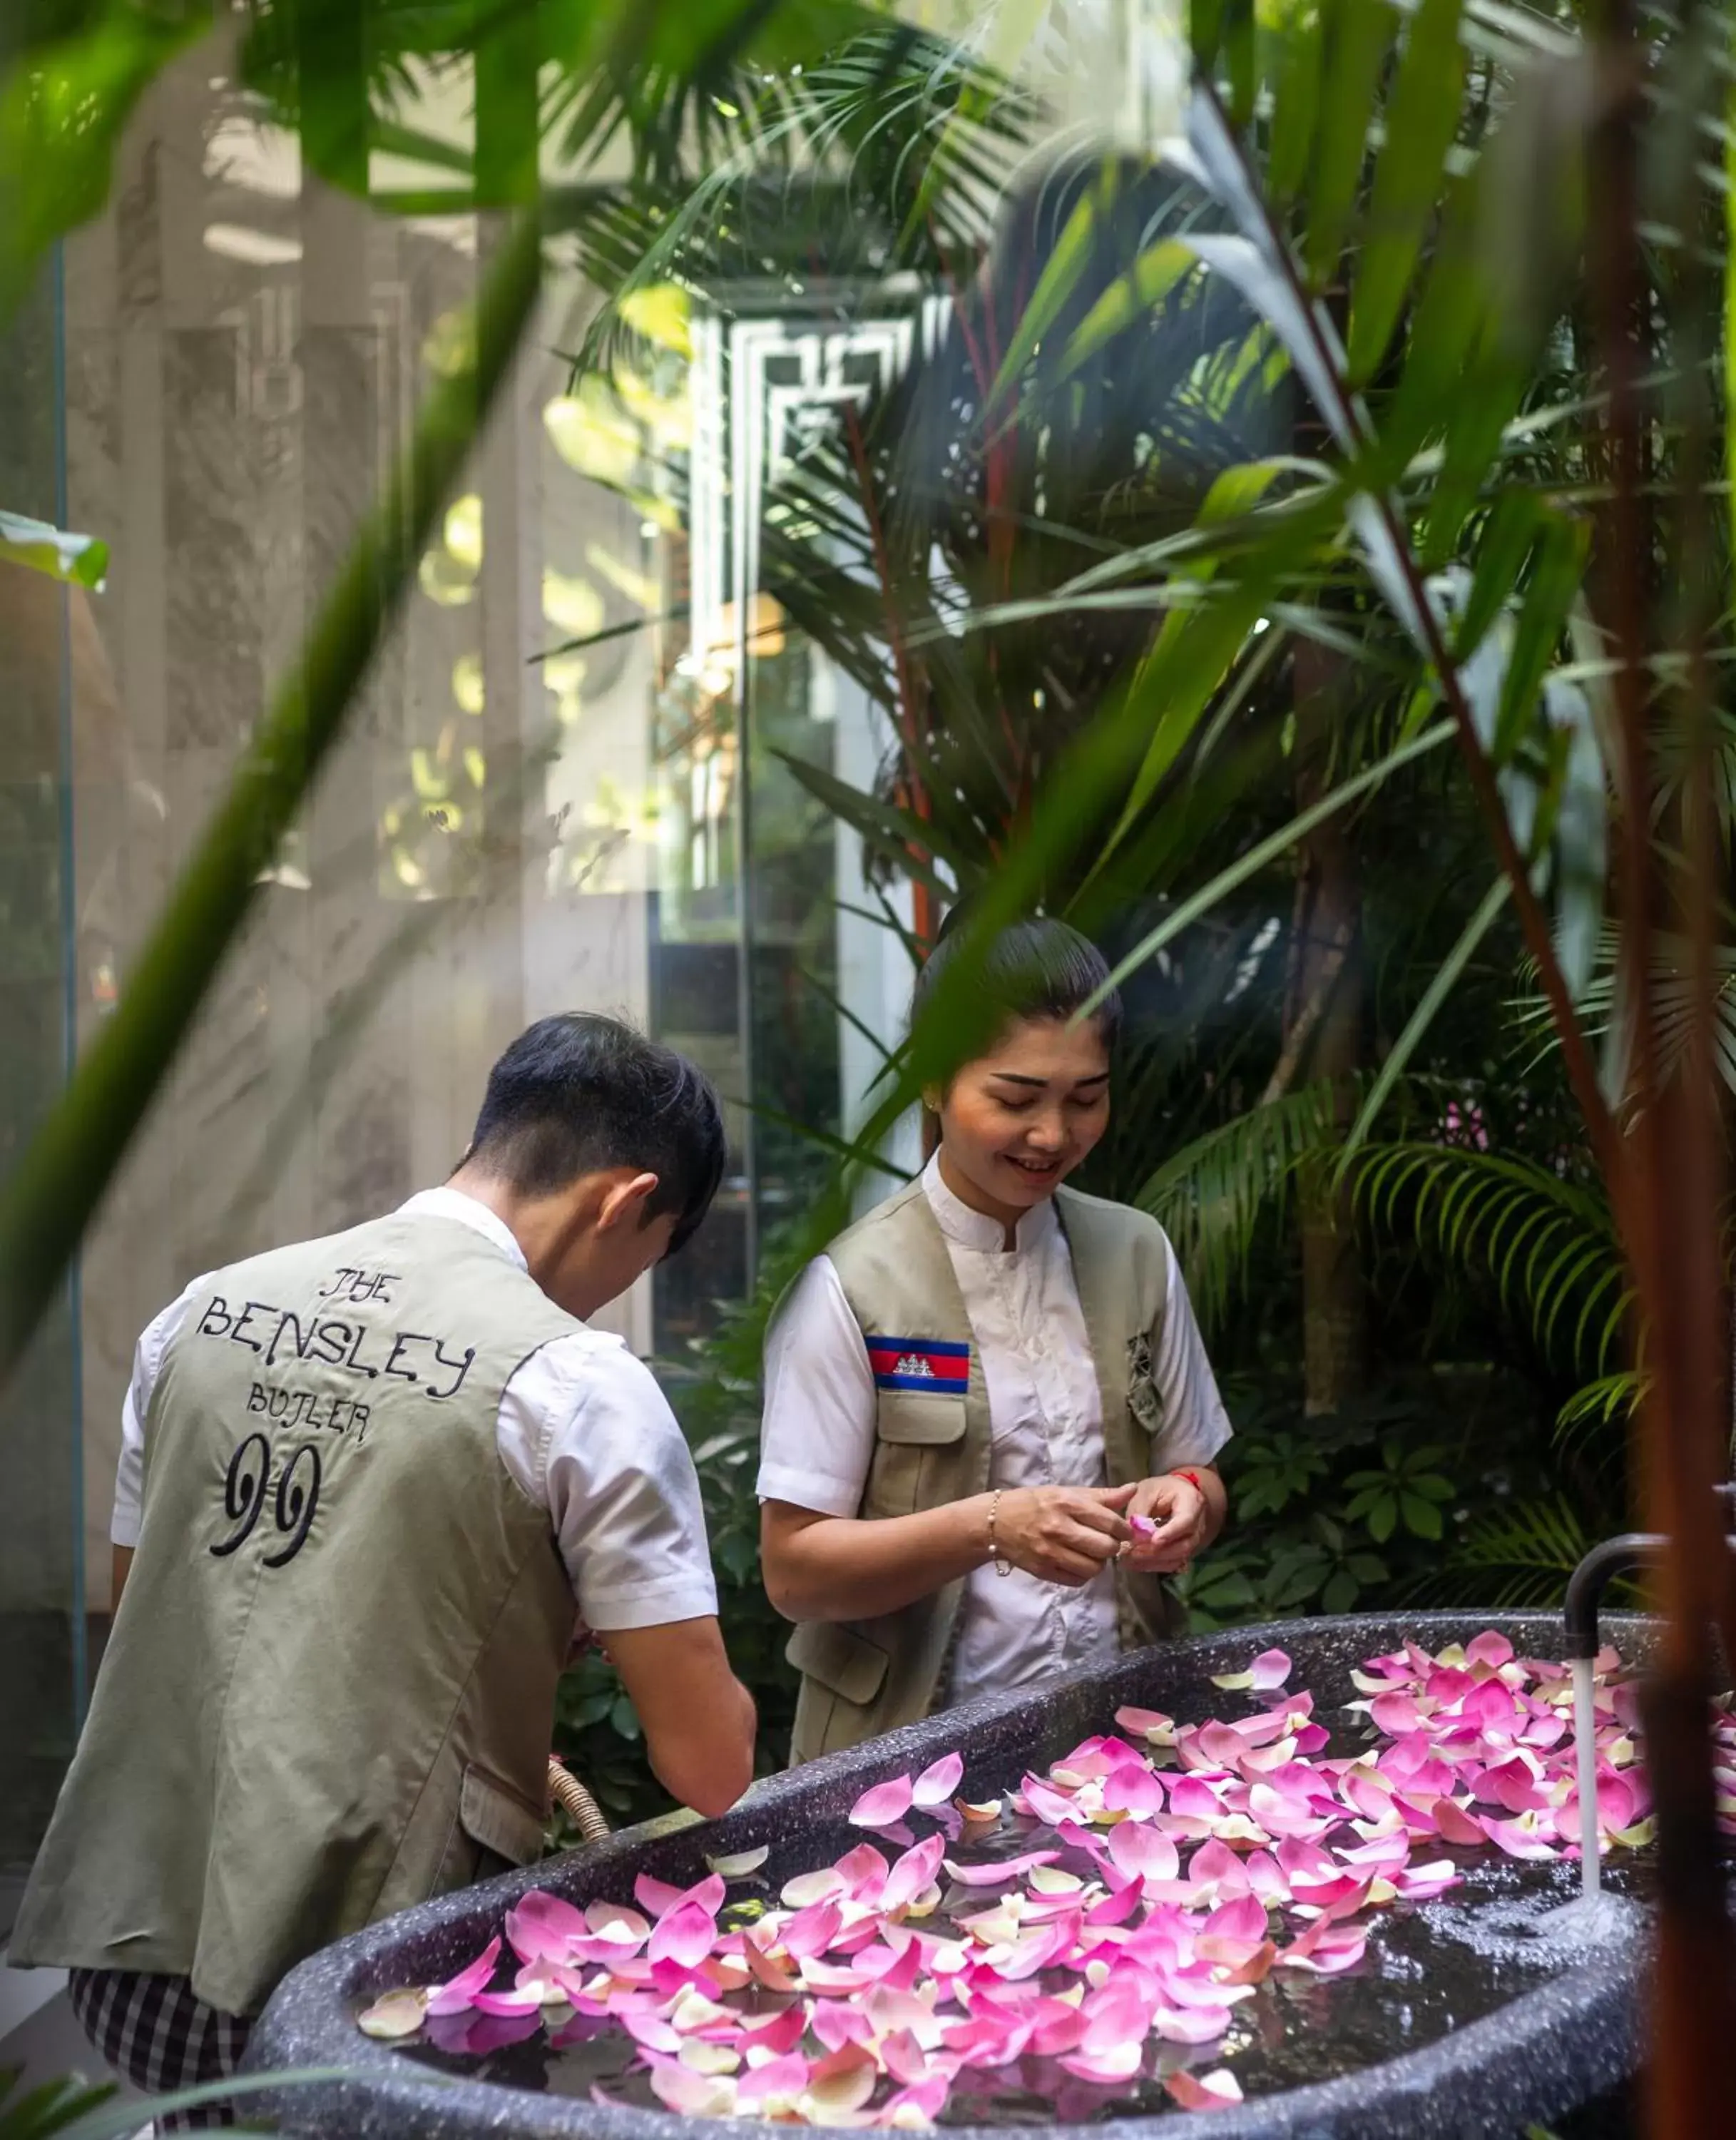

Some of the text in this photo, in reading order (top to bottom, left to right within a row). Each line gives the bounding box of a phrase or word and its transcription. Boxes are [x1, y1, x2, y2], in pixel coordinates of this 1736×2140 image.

[320, 1268, 402, 1303] THE
[196, 1296, 475, 1398] BENSLEY
[247, 1382, 371, 1442] BUTLER
[210, 1433, 321, 1568] 99
